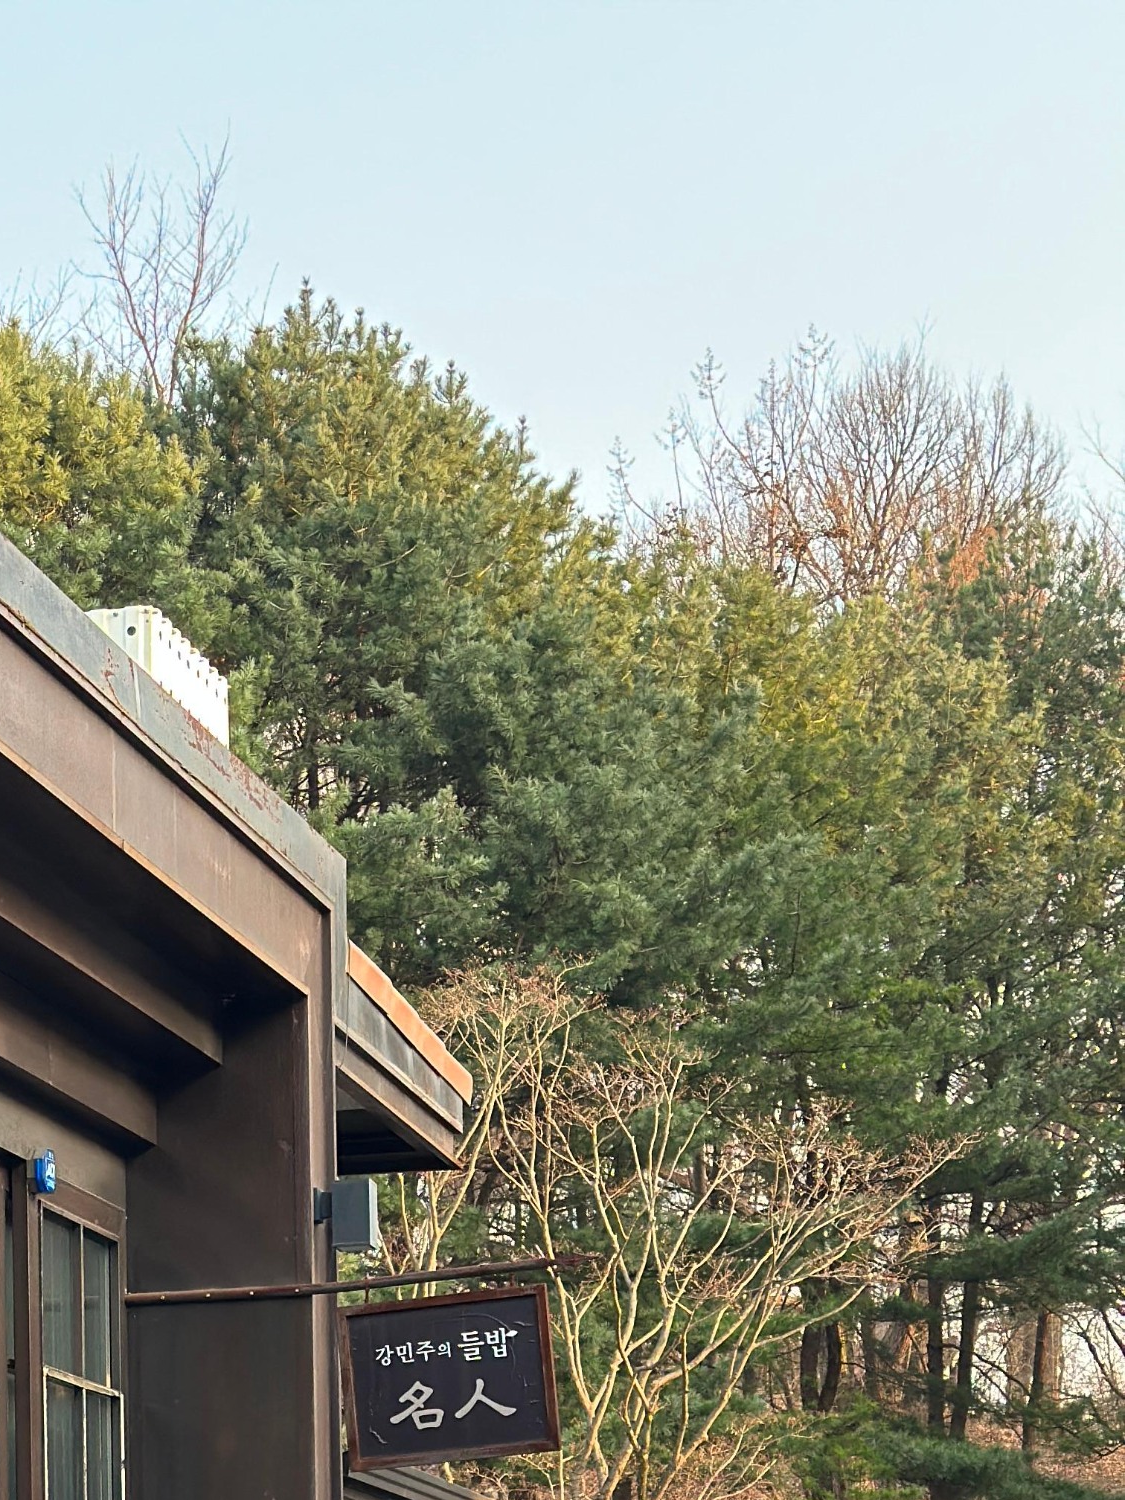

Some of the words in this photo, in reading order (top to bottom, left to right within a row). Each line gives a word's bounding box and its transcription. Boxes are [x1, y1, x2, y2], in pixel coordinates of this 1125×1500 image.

[375, 1340, 452, 1366] 강민주의
[457, 1328, 518, 1361] 들밥
[390, 1378, 517, 1430] 名人
